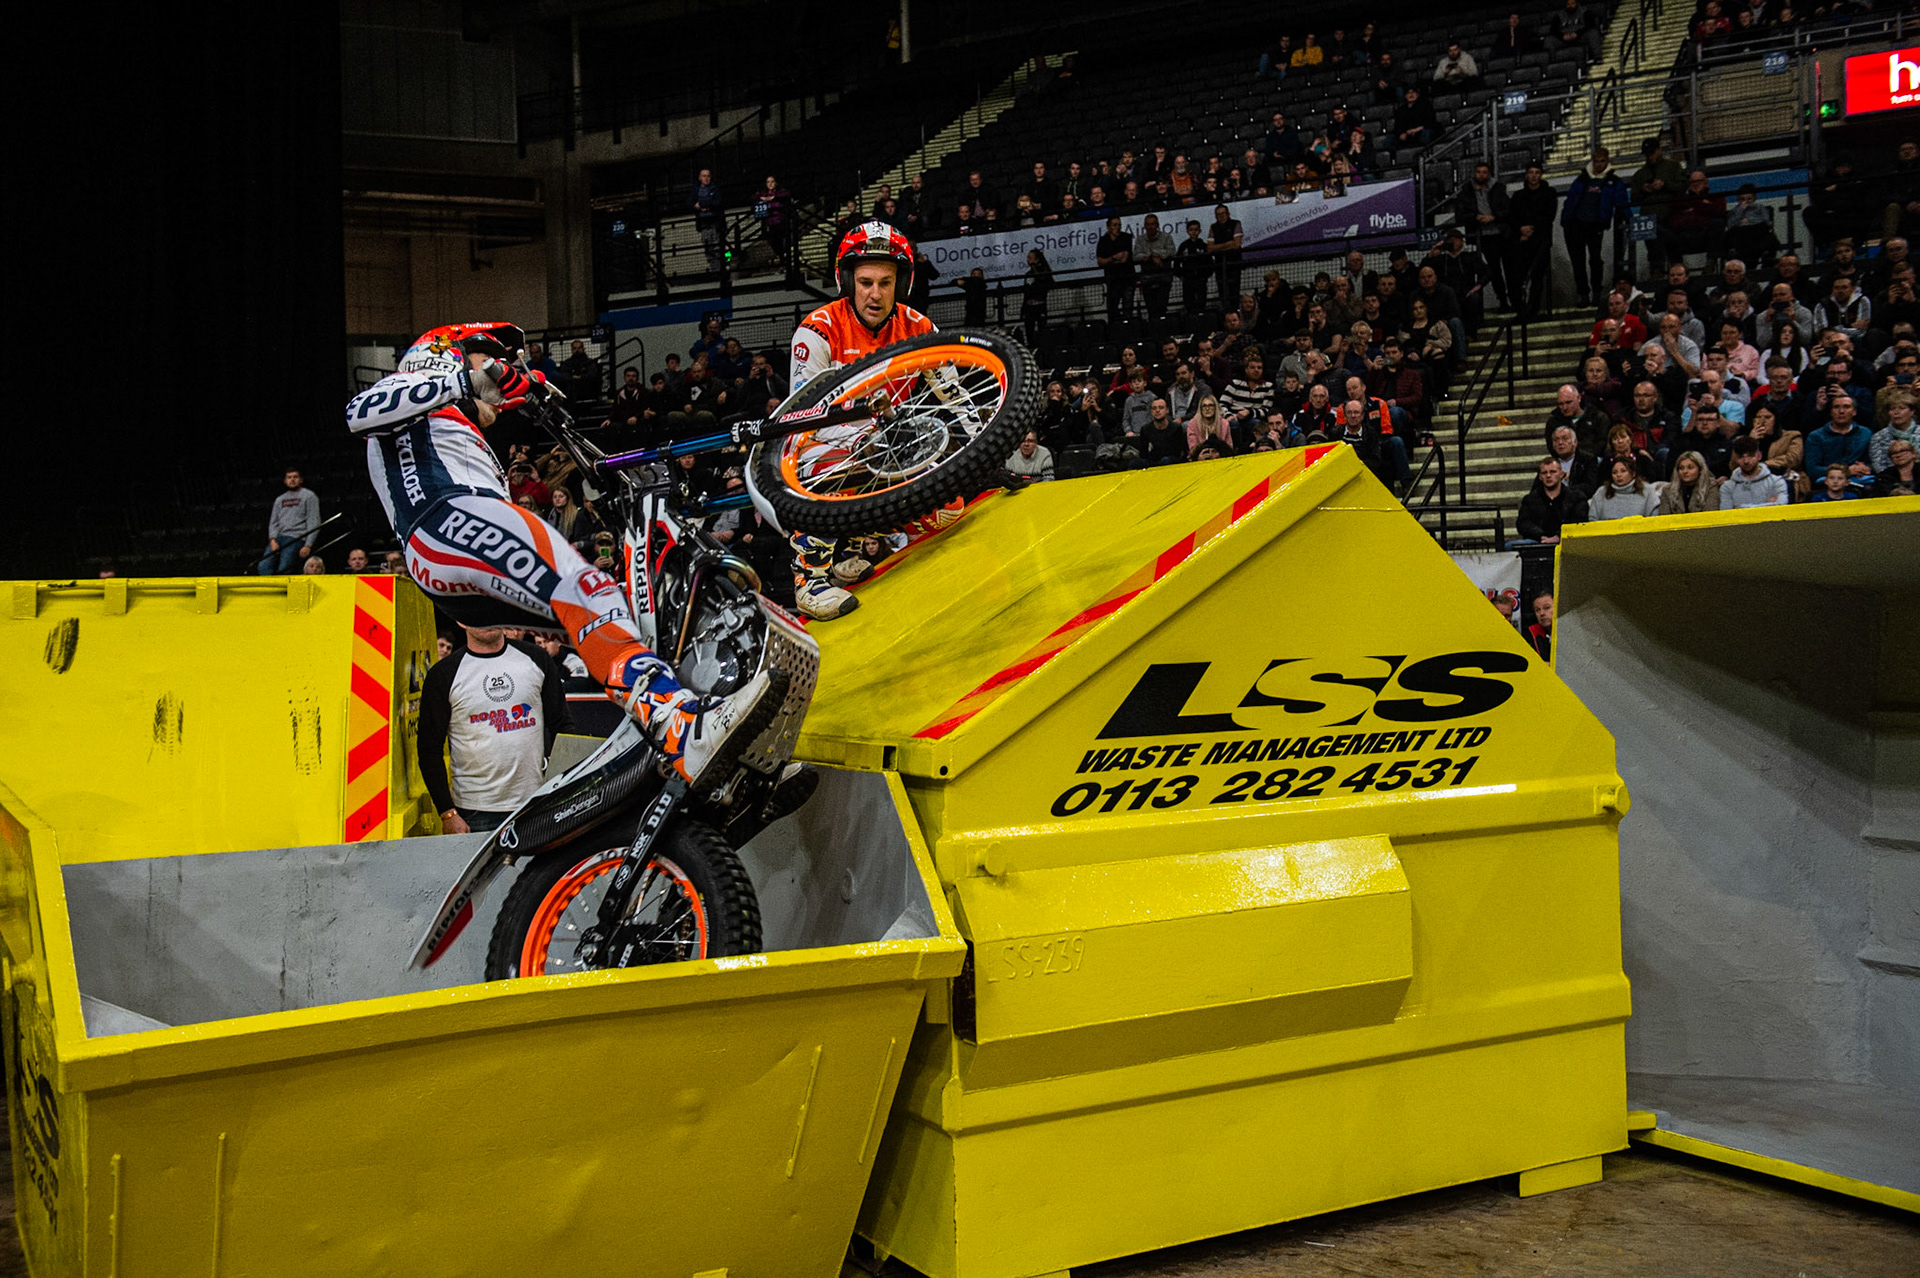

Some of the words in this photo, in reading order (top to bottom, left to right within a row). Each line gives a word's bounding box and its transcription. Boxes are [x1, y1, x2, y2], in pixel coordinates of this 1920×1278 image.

[1266, 203, 1329, 234] flybe.com/dsa
[1632, 220, 1655, 232] 118
[936, 241, 1028, 263] Doncaster
[1034, 227, 1102, 252] Sheffiel
[1124, 217, 1190, 240] Airort
[1419, 233, 1439, 243] 119
[346, 379, 452, 420] EPSOL
[395, 431, 427, 507] HONDA
[437, 511, 550, 594] REPSOL
[635, 541, 650, 615] REPSOL
[491, 677, 505, 687] 25
[1095, 651, 1529, 740] LSS
[469, 709, 508, 724] ROAD
[489, 717, 510, 726] AND
[495, 717, 537, 733] TRIALS
[1076, 742, 1202, 775] WASTE
[1202, 729, 1438, 766] MANAGEMENT
[1437, 726, 1493, 749] LTD
[1050, 774, 1200, 818] 0113
[1209, 765, 1337, 805] 282
[1338, 755, 1481, 794] 4531
[646, 791, 673, 829] DID
[629, 832, 651, 859] NGK
